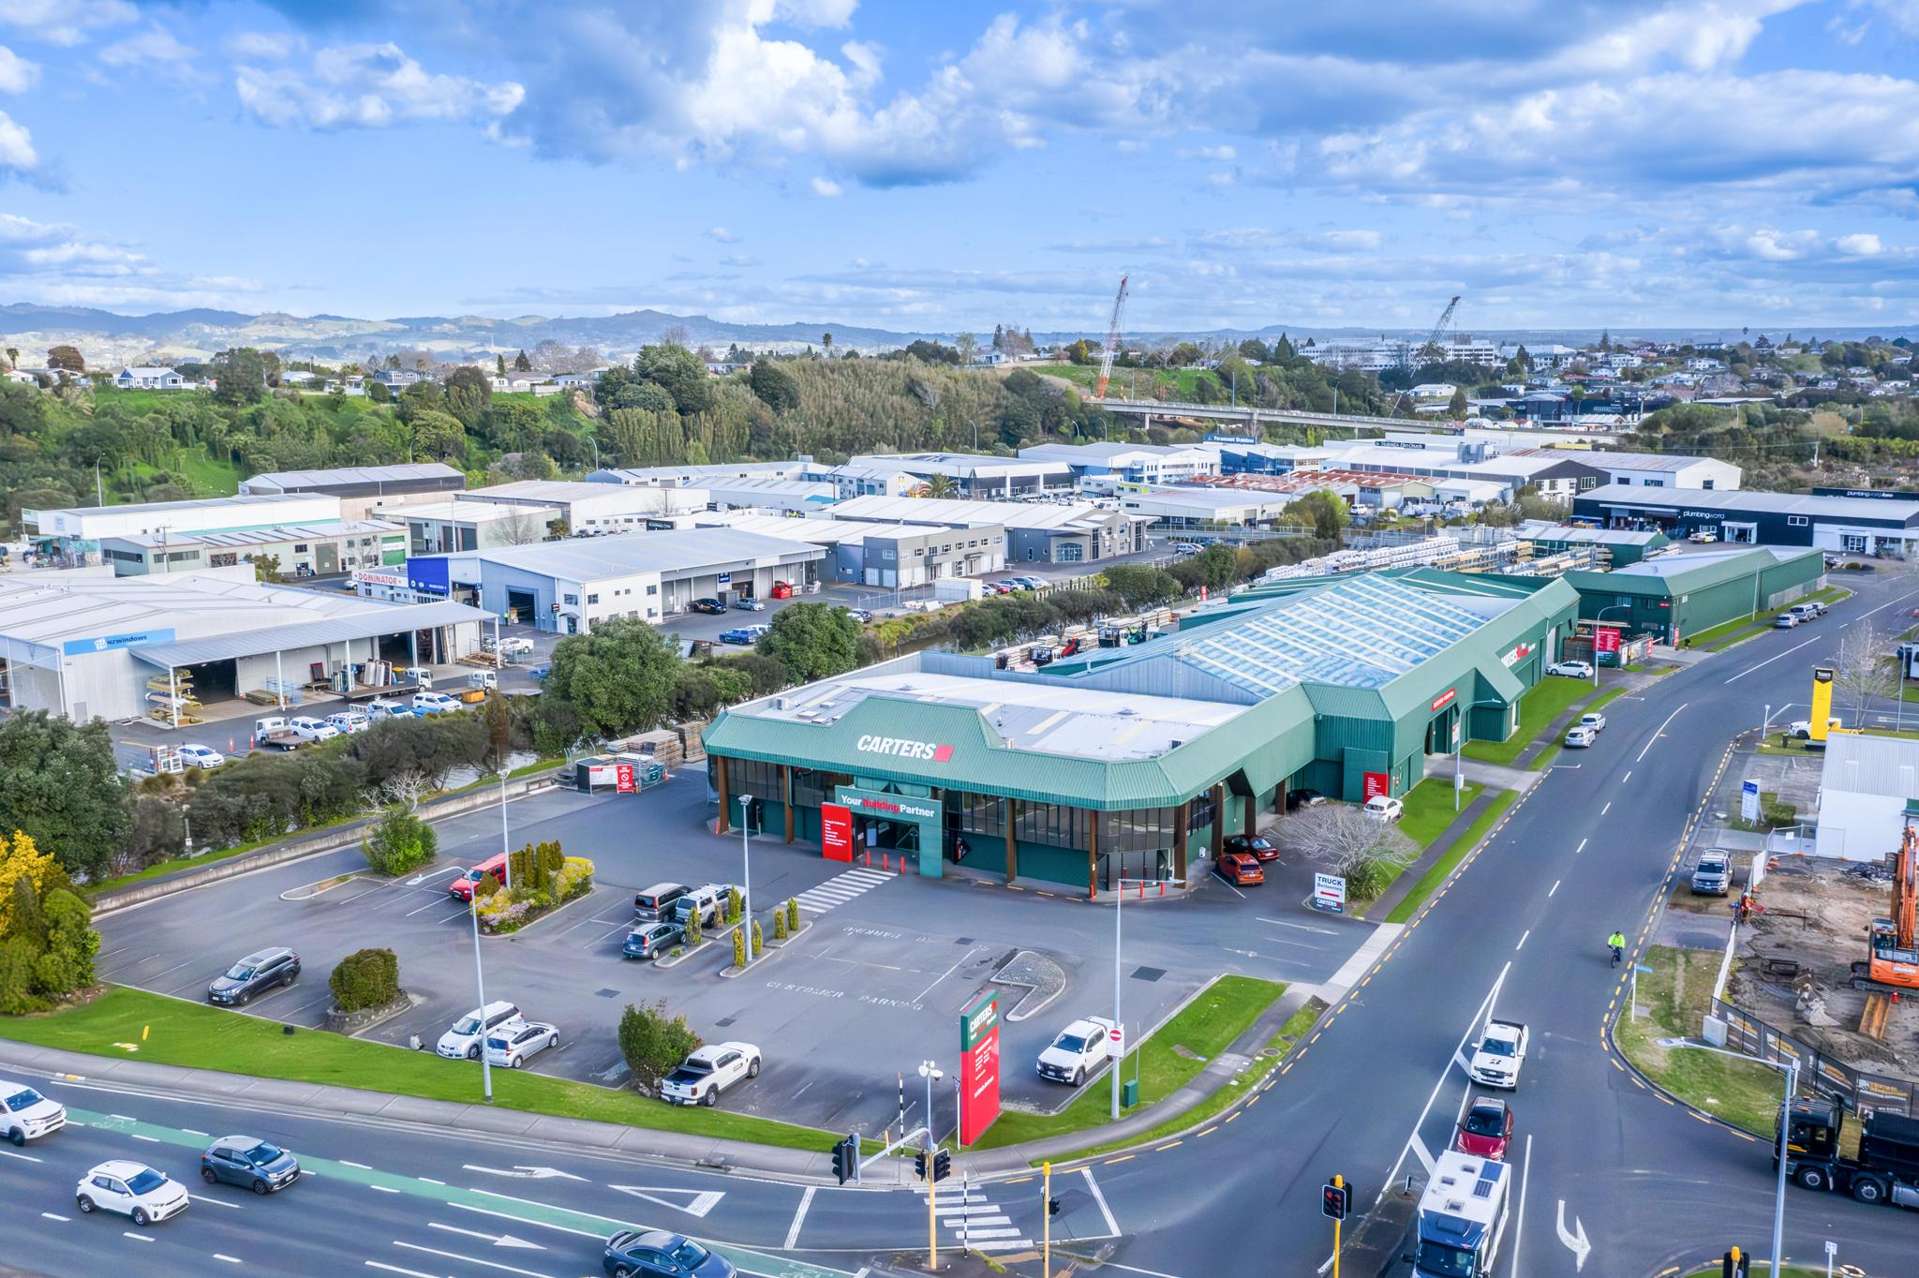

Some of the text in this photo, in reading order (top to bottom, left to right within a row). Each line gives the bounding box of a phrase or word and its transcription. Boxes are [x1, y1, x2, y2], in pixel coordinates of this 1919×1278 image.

[358, 572, 398, 584] DOMINATOR
[857, 734, 937, 760] CARTERS
[840, 794, 862, 807] Your
[900, 803, 935, 818] Partner
[1317, 876, 1342, 886] TRUCK
[857, 994, 924, 1011] PARKING
